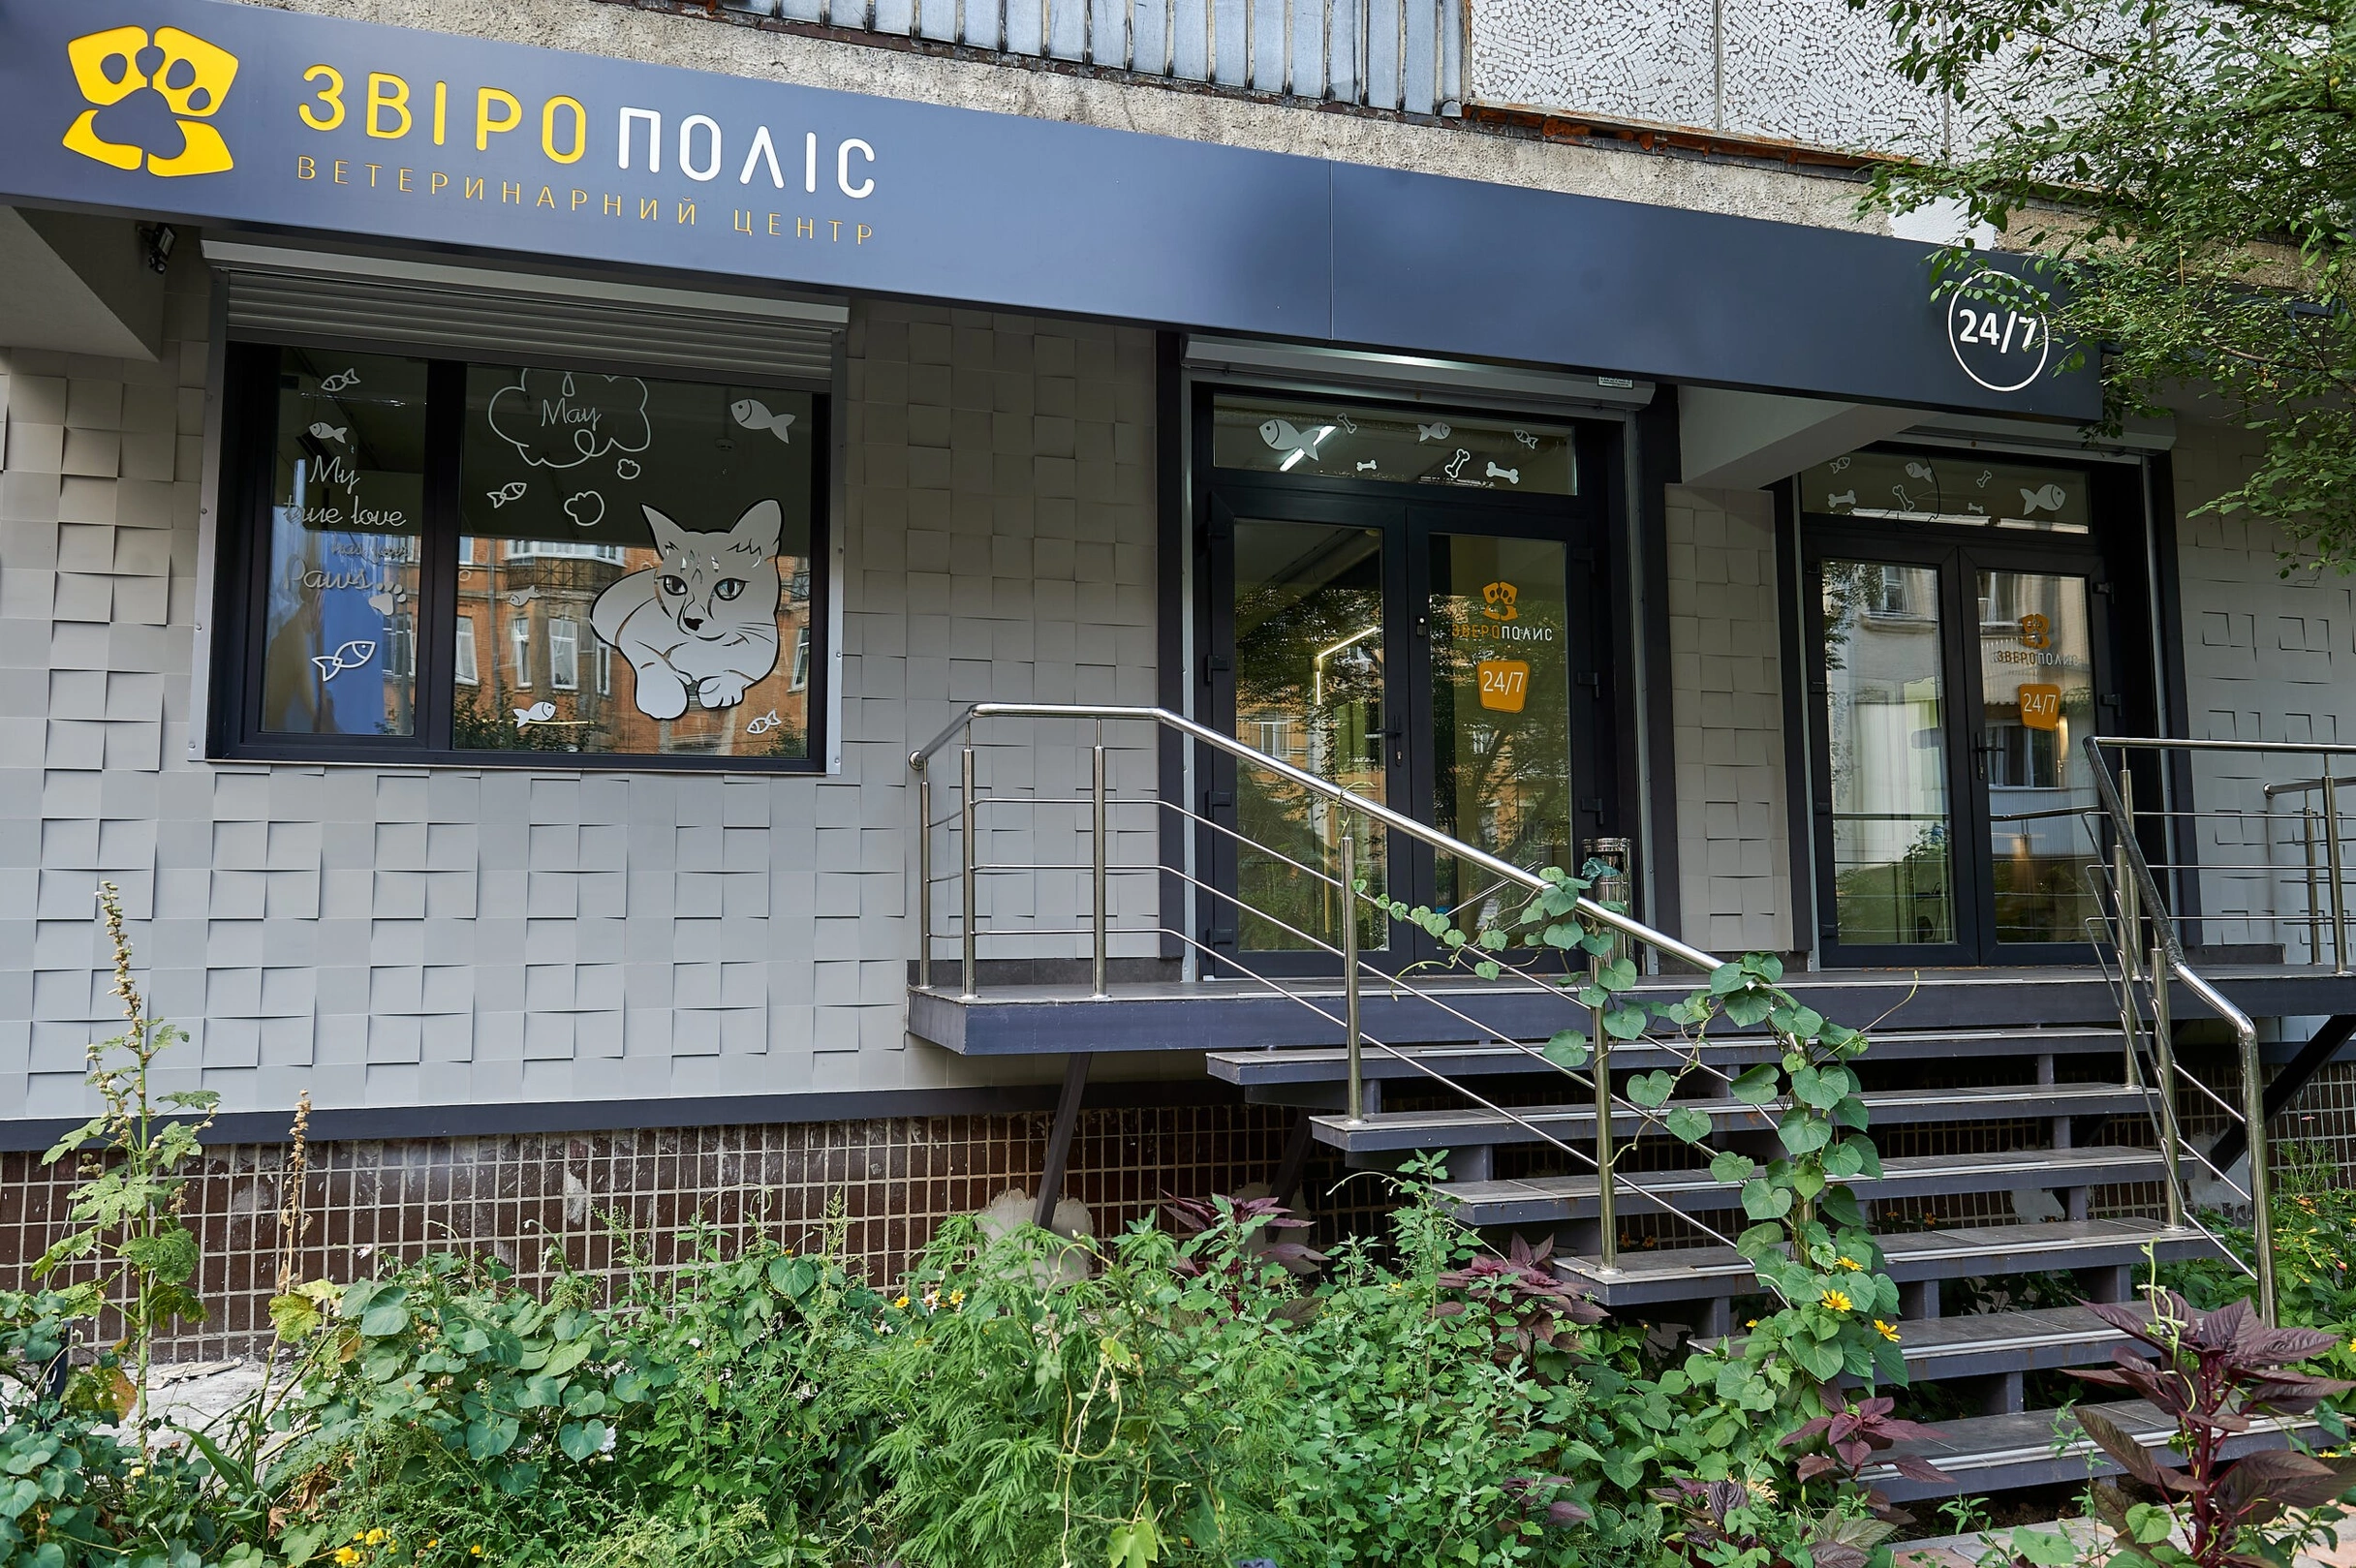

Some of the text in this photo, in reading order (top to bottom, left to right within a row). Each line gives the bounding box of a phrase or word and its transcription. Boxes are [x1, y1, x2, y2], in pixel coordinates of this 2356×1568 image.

[297, 155, 873, 245] ВЕТЕРИНАРНИЙ ЦЕНТР
[1959, 309, 2037, 354] 24/7
[541, 397, 602, 431] May
[309, 454, 360, 495] My
[283, 495, 407, 527] true love
[1483, 670, 1524, 695] 24/7
[2023, 692, 2057, 716] 24/7
